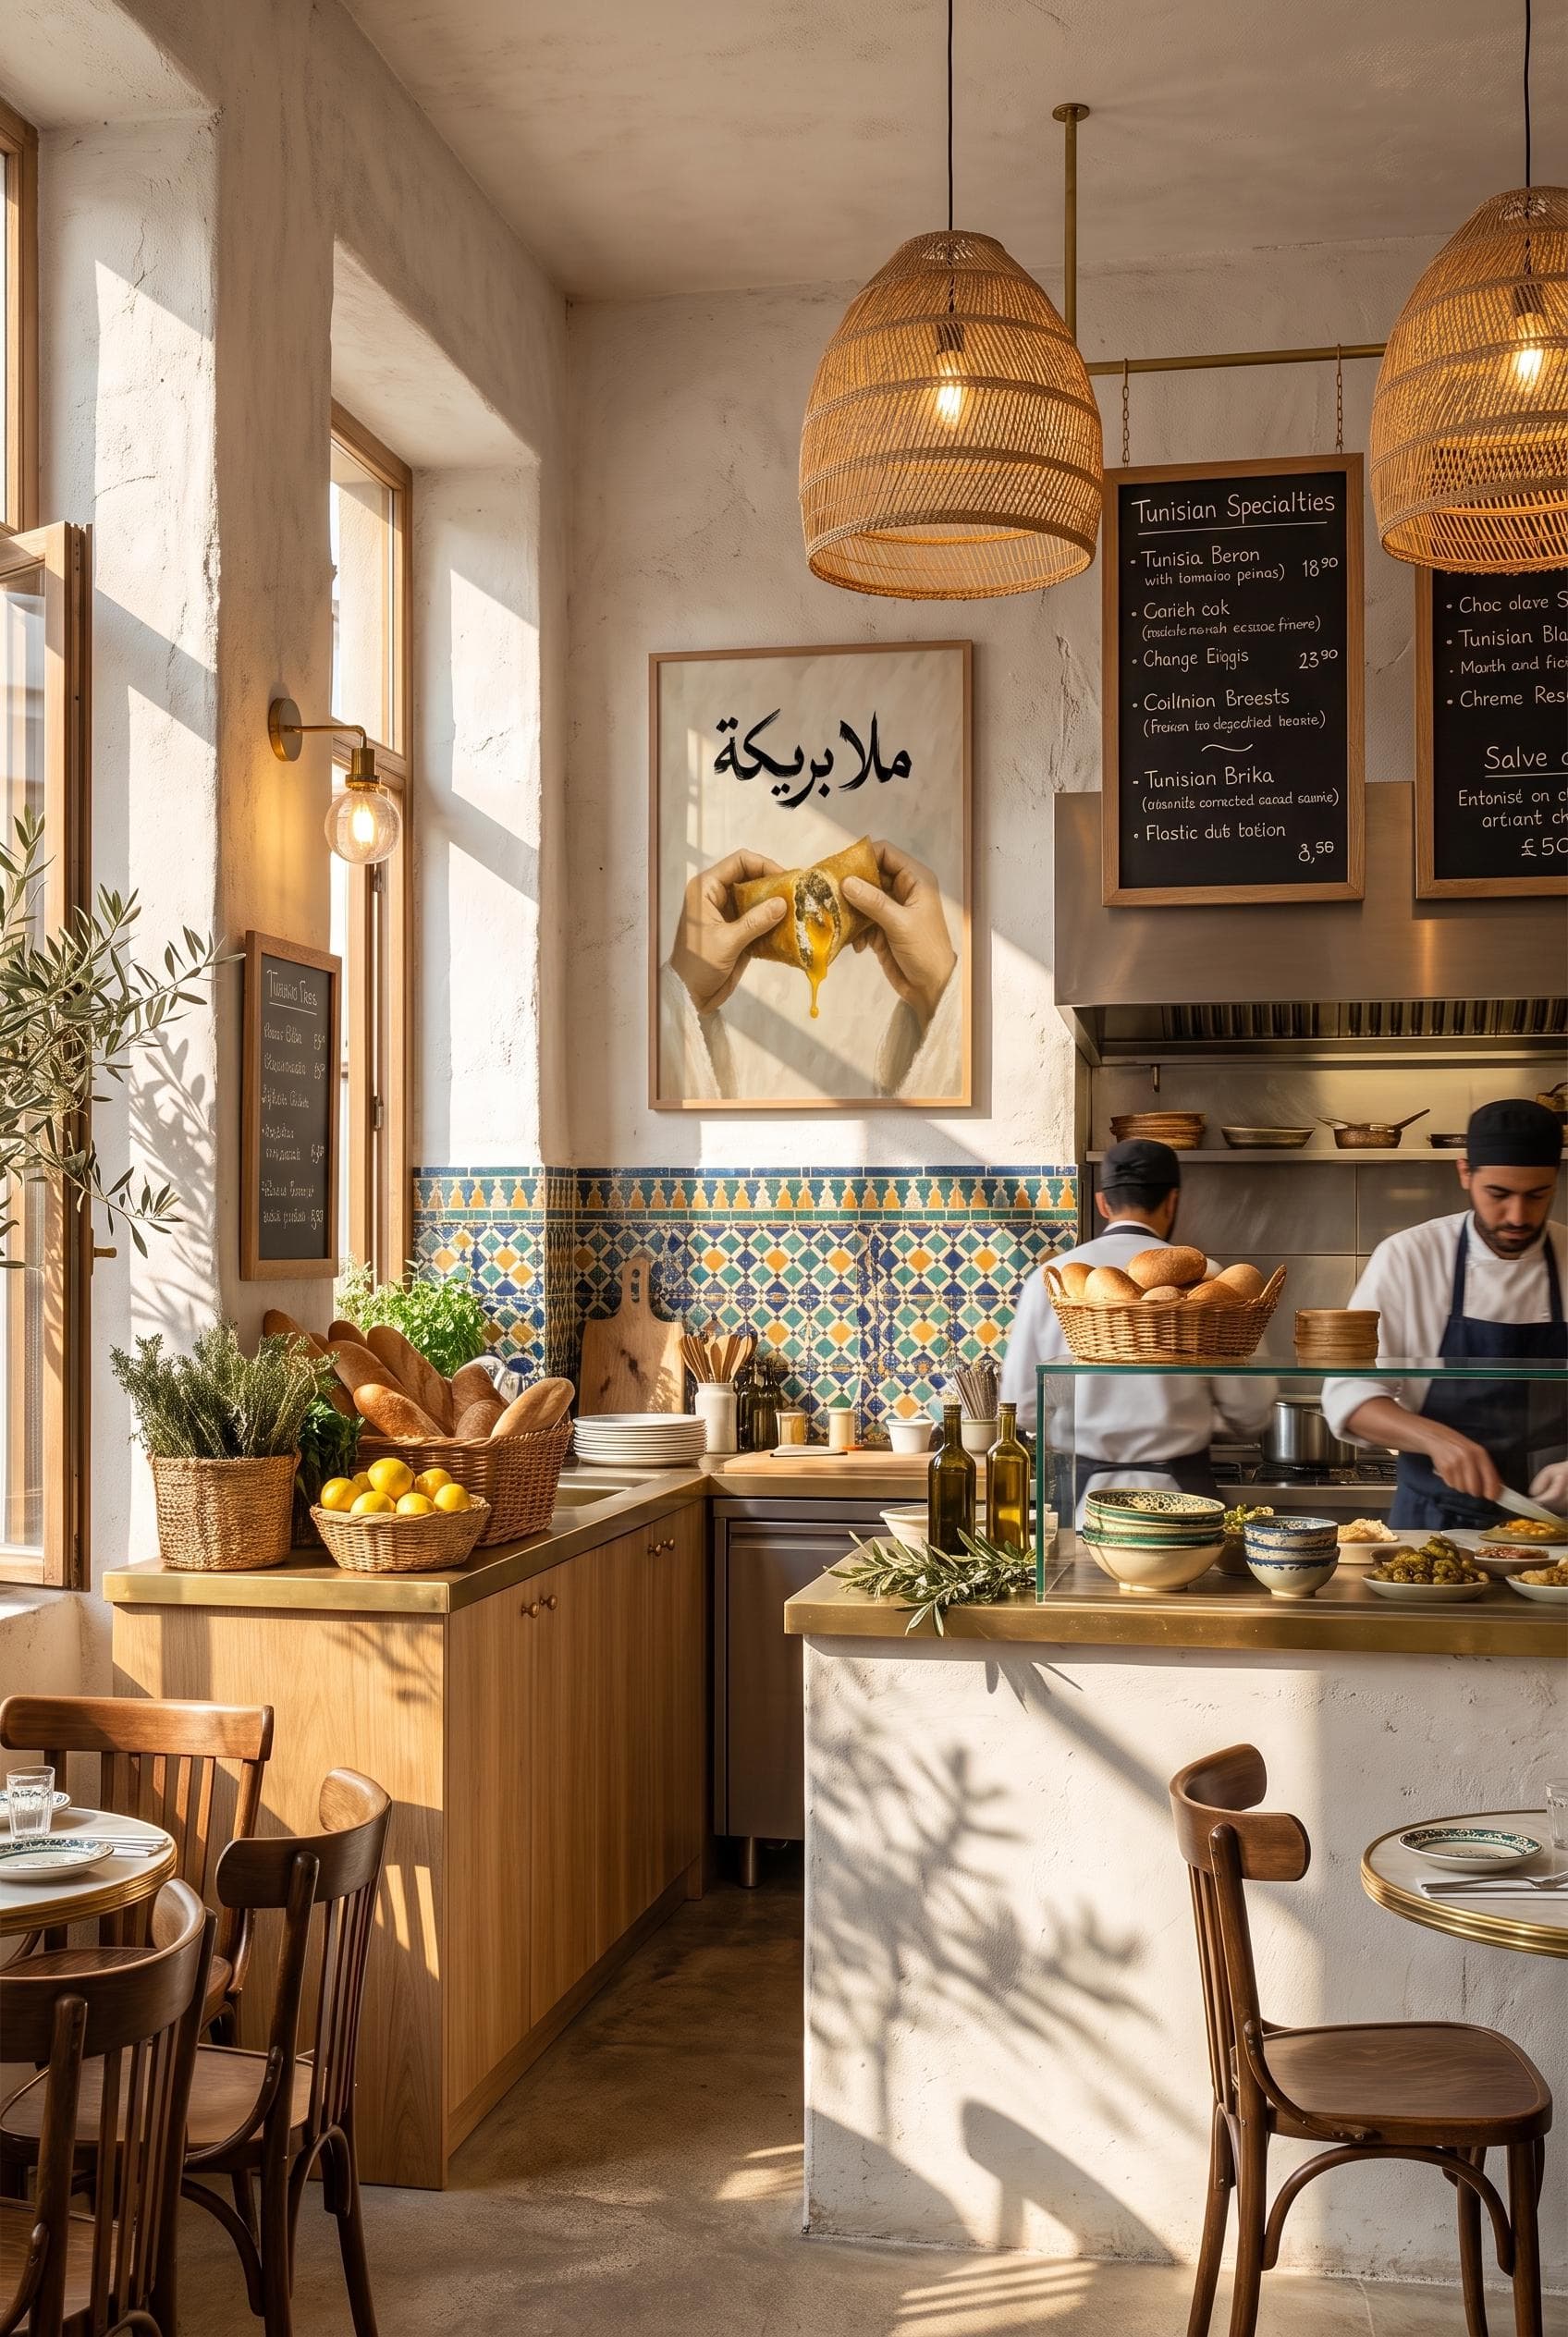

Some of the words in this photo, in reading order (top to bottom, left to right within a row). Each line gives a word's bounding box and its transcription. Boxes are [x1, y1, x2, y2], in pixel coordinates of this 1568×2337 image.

[1131, 498, 1217, 524] Tunisian
[1227, 491, 1335, 525] Specialties
[1140, 550, 1204, 568] Tunisia
[1211, 545, 1260, 565] Beron
[1145, 572, 1173, 586] with
[1459, 596, 1502, 614] Choc
[1457, 629, 1533, 648] Tunisian
[1143, 649, 1199, 673] Change
[1460, 689, 1524, 708] Chreme
[1484, 745, 1548, 770] Salve
[1144, 769, 1217, 789] Tunisian
[1224, 765, 1275, 786] Brika
[1531, 792, 1550, 802] on
